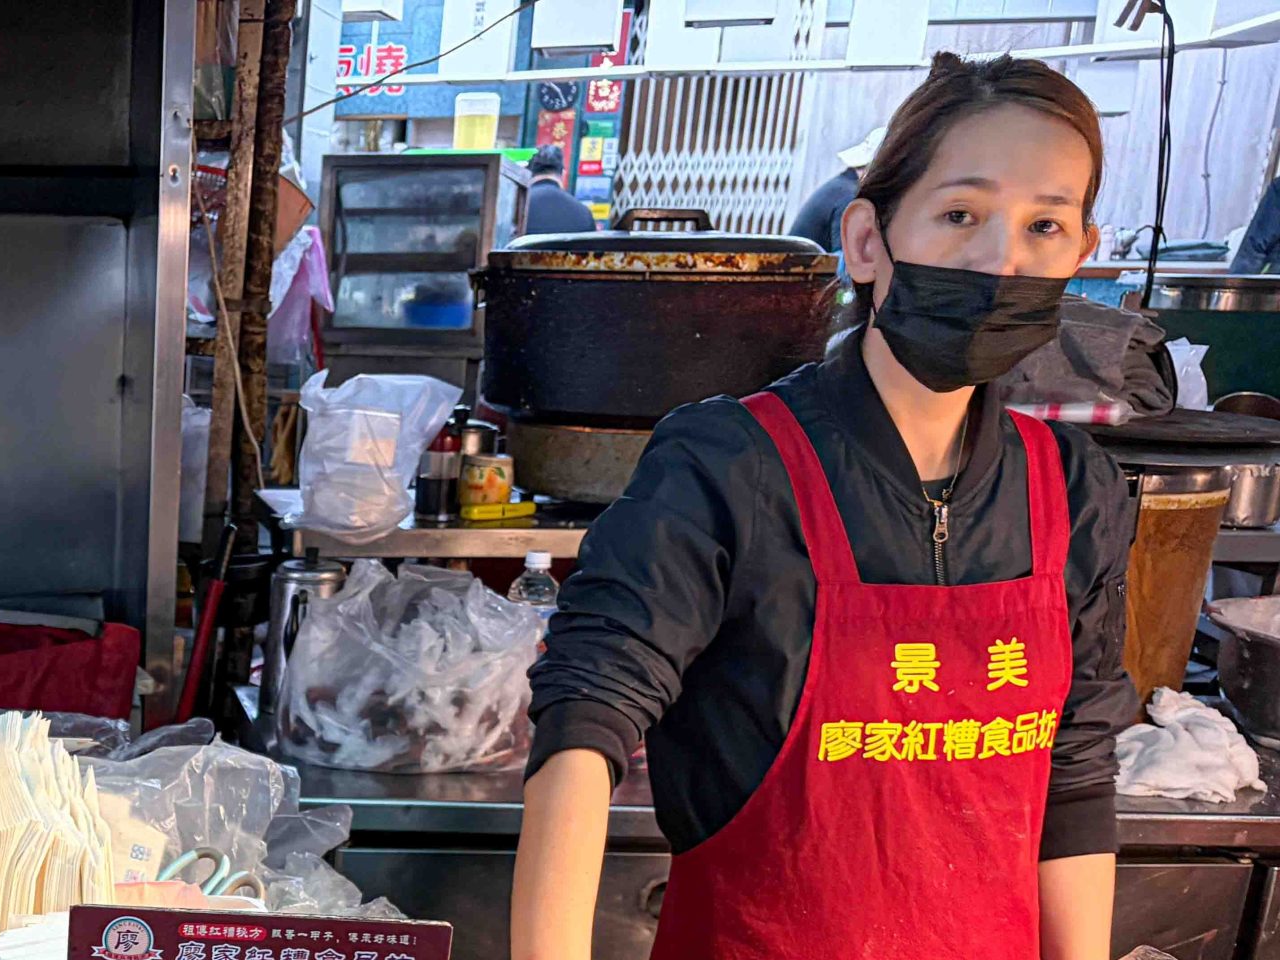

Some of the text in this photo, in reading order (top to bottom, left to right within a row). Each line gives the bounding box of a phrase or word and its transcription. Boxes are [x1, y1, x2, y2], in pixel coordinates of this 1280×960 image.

[818, 709, 1057, 762] 廖家紅糟食品坊
